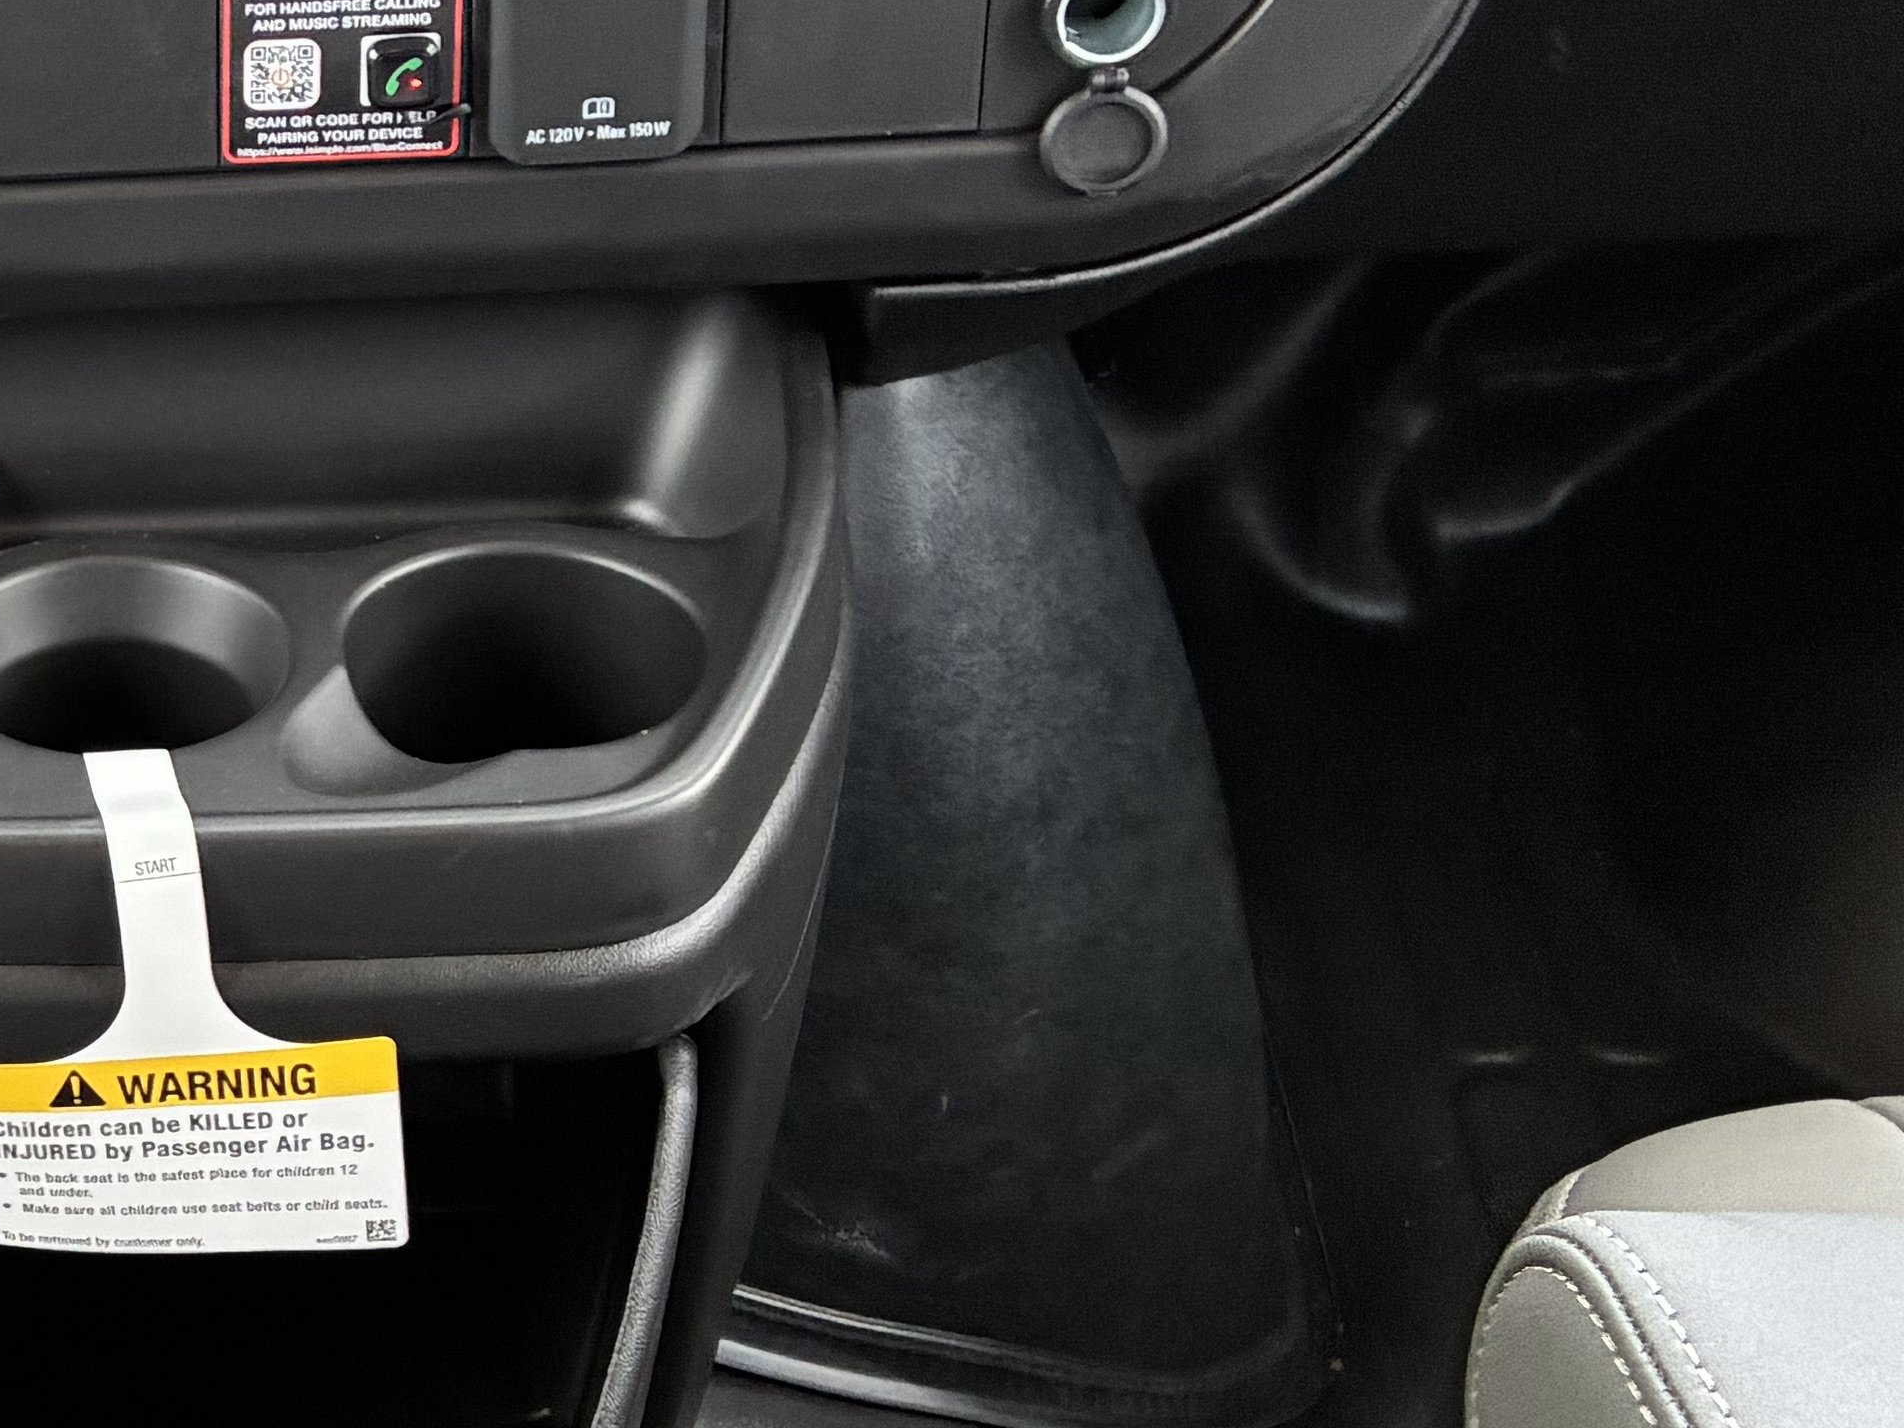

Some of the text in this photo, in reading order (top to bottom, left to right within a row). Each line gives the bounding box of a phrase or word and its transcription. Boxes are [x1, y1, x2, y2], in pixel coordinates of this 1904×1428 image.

[244, 2, 277, 17] FOR
[252, 12, 432, 34] AND MUSIC STREAMING
[244, 115, 287, 131] SCAN
[289, 115, 312, 129] QR
[314, 112, 359, 128] CODE
[362, 111, 394, 125] FOR
[257, 126, 424, 145] PAIRING YOUR DEVICE
[525, 128, 546, 145] AC
[596, 124, 626, 139] Max
[134, 857, 177, 876] START
[117, 1063, 317, 1104] WARNING
[100, 1121, 142, 1137] can
[152, 1117, 180, 1133] be
[189, 1112, 273, 1131] KILLED
[282, 1112, 308, 1128] or
[105, 1143, 133, 1162] by
[142, 1138, 268, 1158] Passenger
[276, 1134, 312, 1153] Air
[320, 1132, 375, 1152] Bag.
[15, 1164, 358, 1184] The back seat is the safest place for children 12
[19, 1187, 44, 1196] and
[22, 1203, 59, 1215] Make
[64, 1206, 95, 1215] sure
[99, 1205, 116, 1216] all
[120, 1203, 177, 1216] children
[182, 1203, 207, 1214] use
[212, 1201, 242, 1213] seat
[246, 1201, 281, 1212] belts
[285, 1201, 301, 1211] or
[304, 1198, 339, 1211] child
